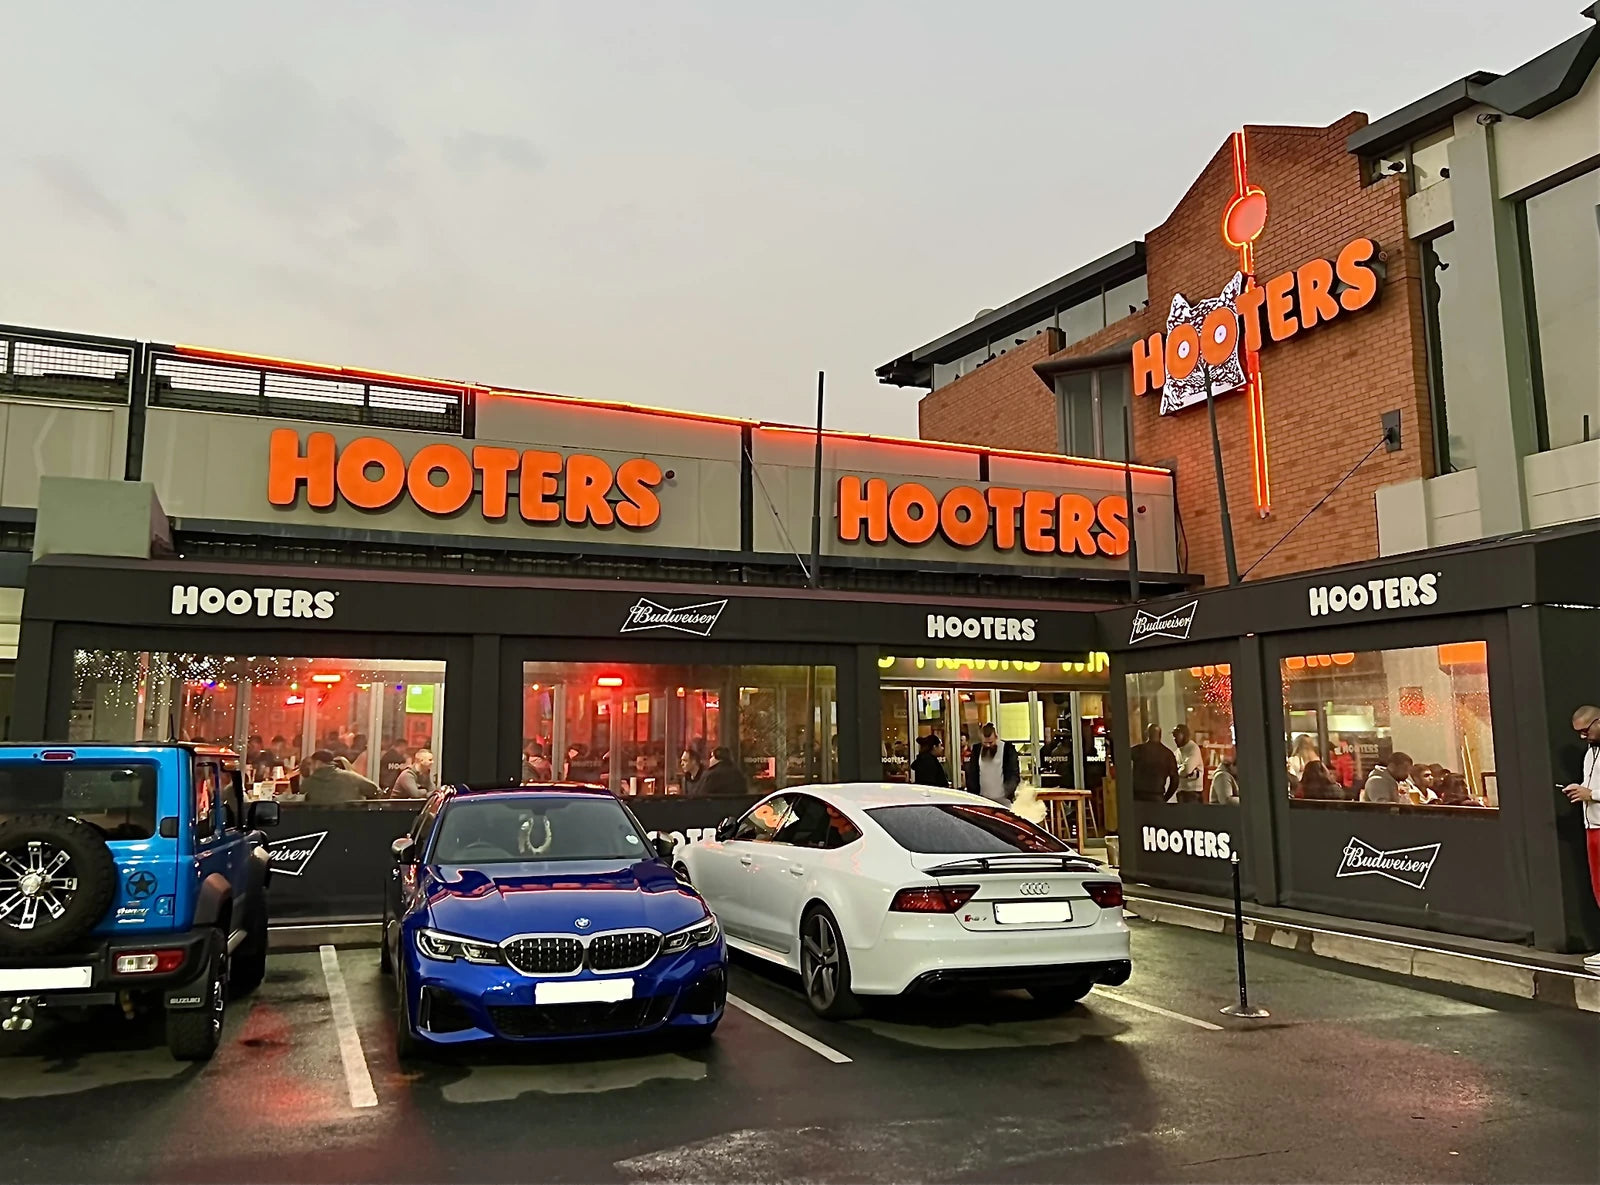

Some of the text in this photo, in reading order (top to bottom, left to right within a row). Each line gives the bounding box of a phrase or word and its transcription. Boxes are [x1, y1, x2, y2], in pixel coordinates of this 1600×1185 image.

[1132, 238, 1377, 396] HOOTERS
[267, 428, 662, 527] HOOTERS
[838, 476, 1130, 556] HOOTERS
[171, 585, 336, 619] HOOTERS
[1308, 573, 1438, 617] HOOTERS
[629, 605, 716, 624] Budweiser
[926, 614, 1036, 642] HOOTERS
[1132, 614, 1191, 634] Budweiser
[268, 845, 312, 861] eiser
[1142, 826, 1231, 859] HOOTERS
[1342, 846, 1429, 872] Budweiser
